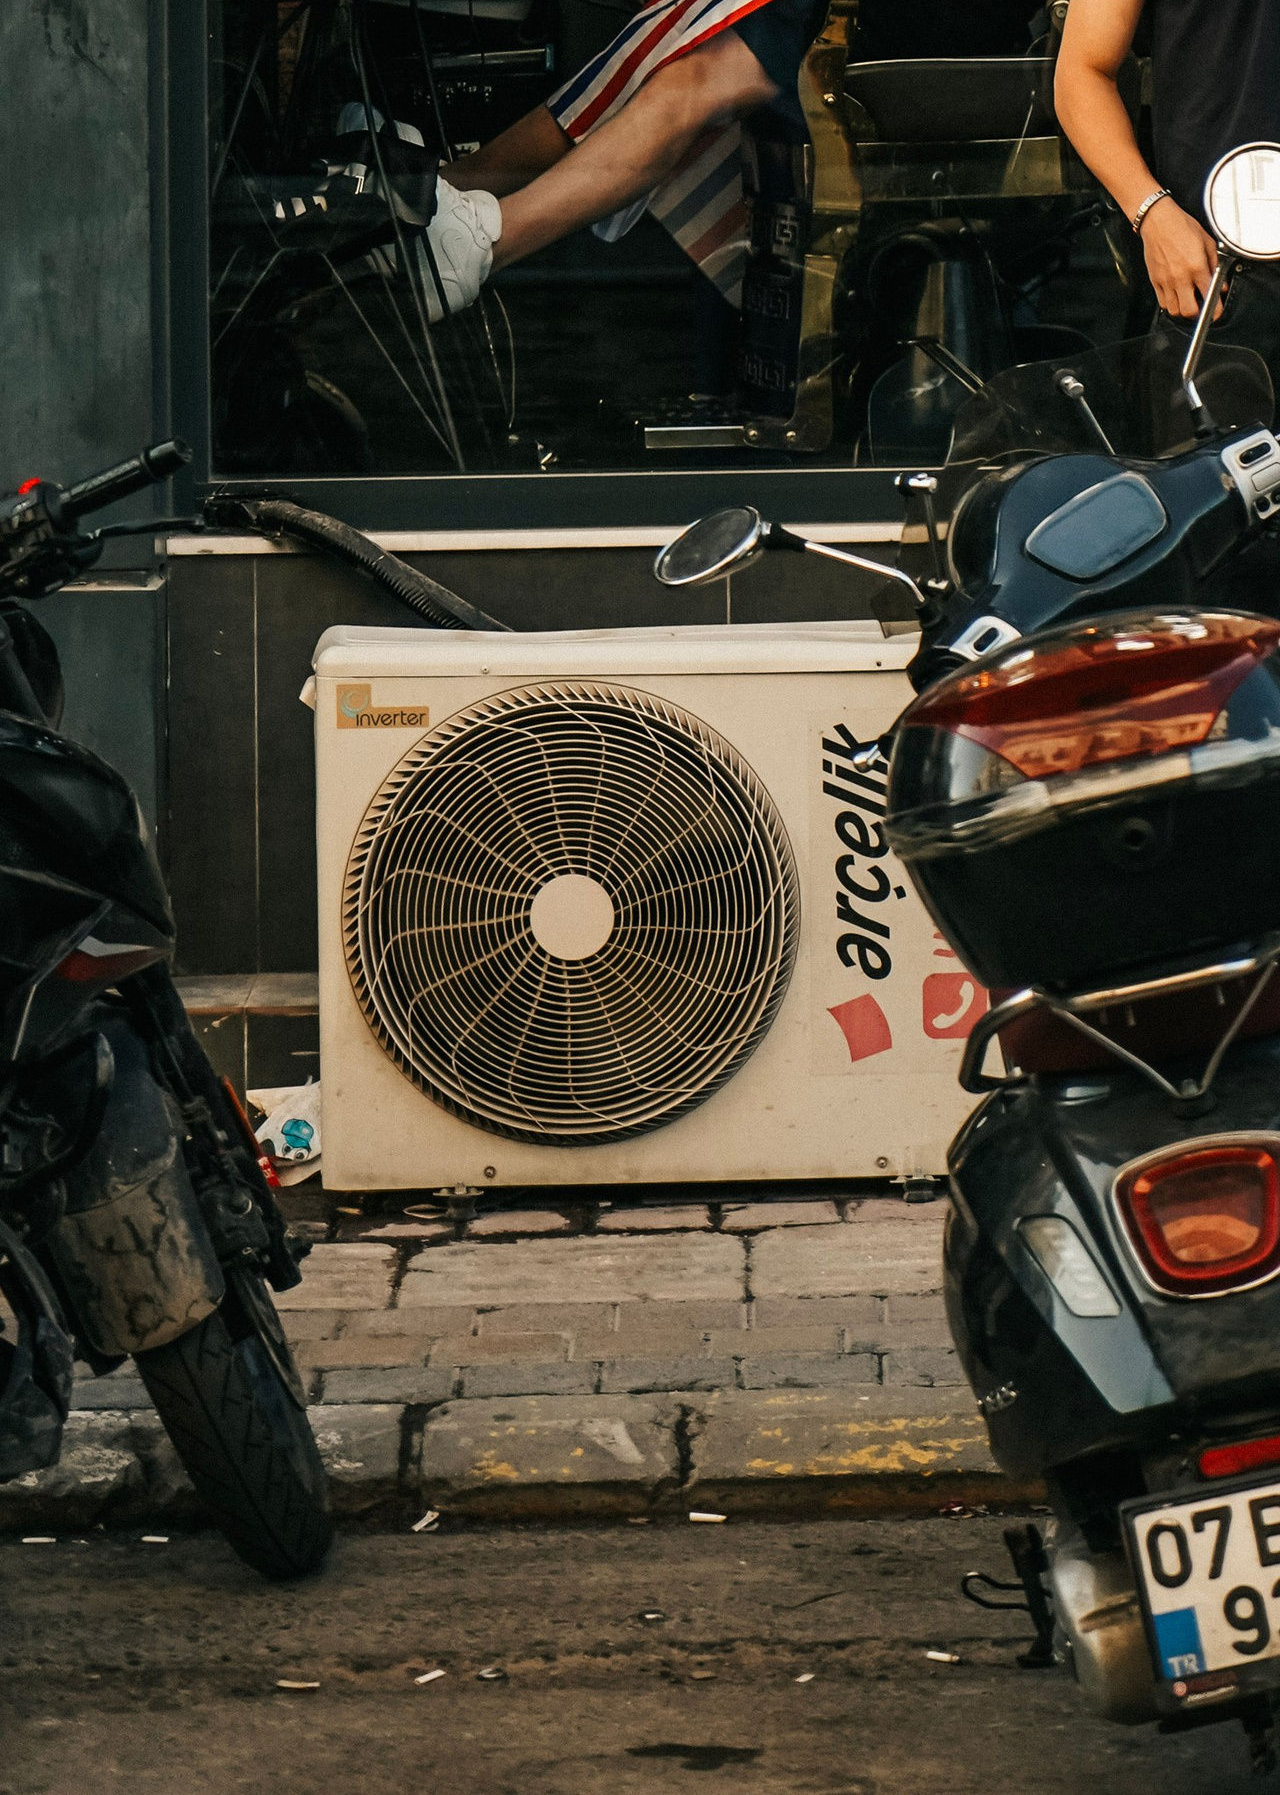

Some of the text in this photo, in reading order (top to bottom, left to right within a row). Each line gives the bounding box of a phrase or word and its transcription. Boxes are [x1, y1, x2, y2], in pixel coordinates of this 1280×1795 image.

[356, 710, 427, 727] inverter
[822, 723, 907, 981] arçelik
[1144, 1505, 1232, 1590] 07
[1167, 1652, 1201, 1678] TR
